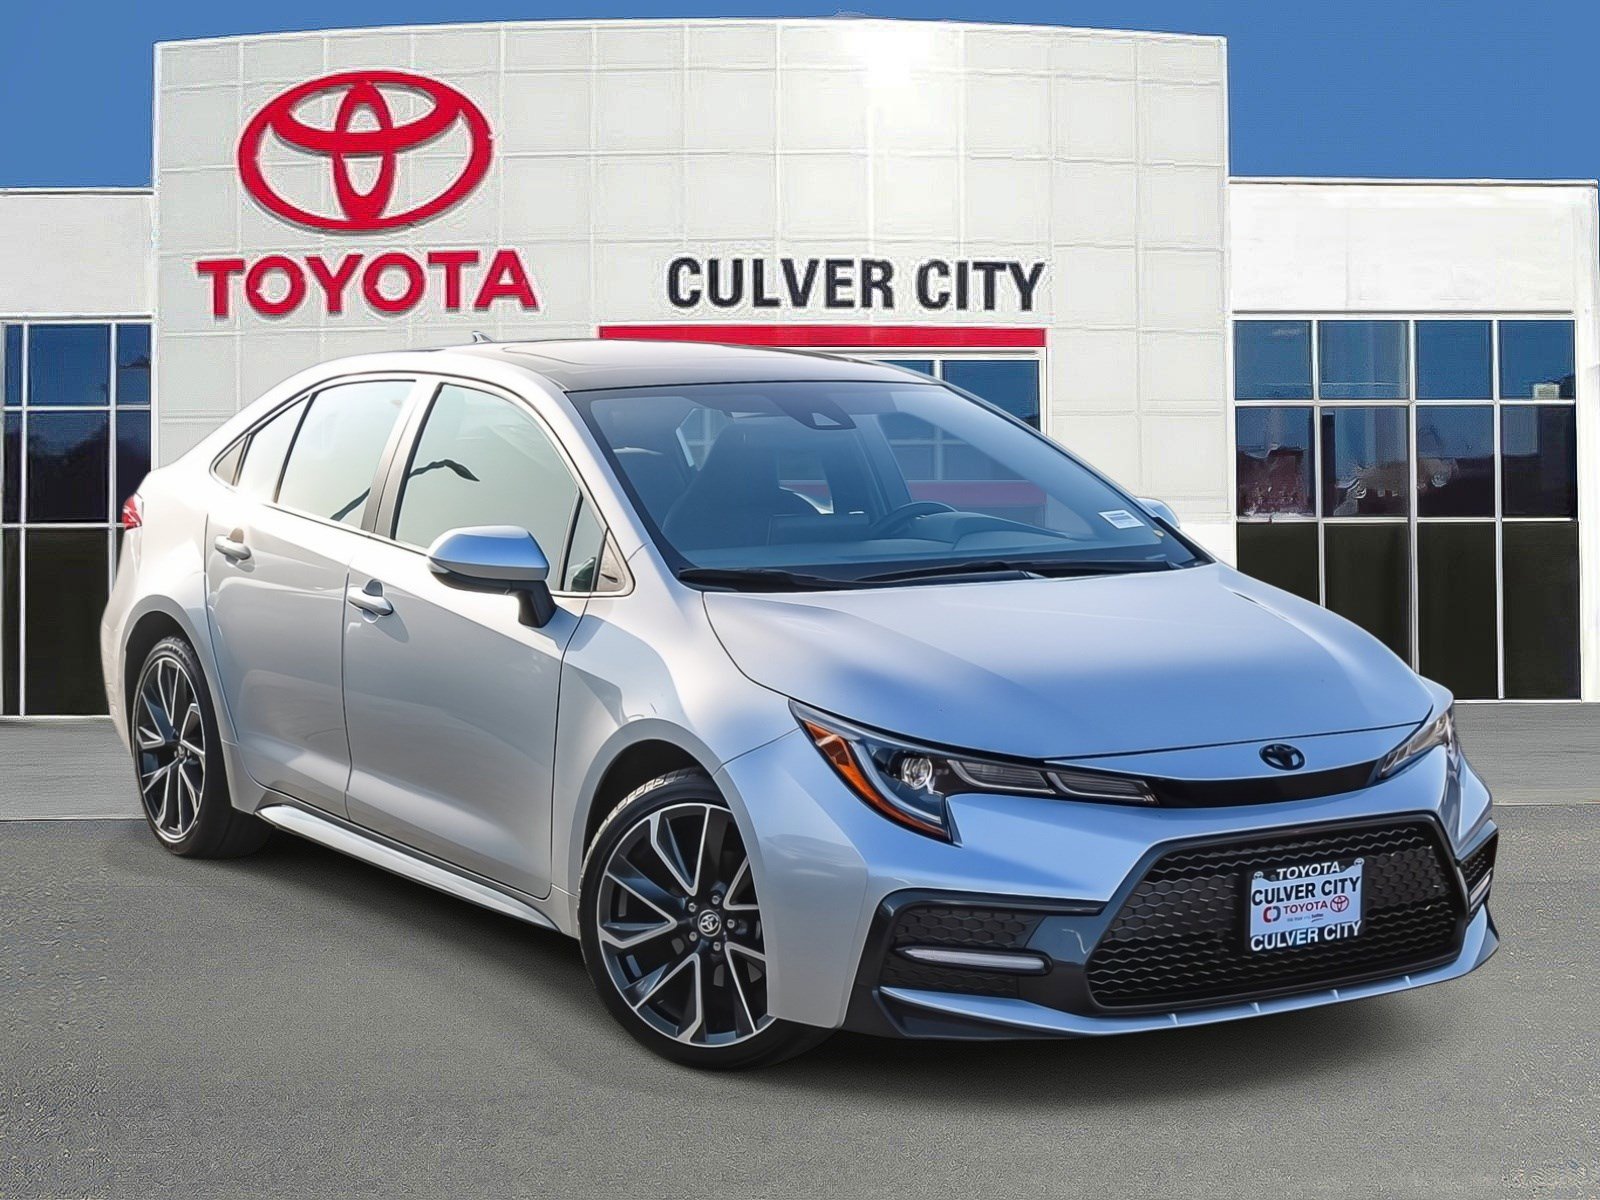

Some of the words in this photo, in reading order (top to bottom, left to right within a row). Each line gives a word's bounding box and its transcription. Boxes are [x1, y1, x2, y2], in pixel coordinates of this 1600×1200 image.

[195, 250, 540, 319] TOYOTA
[667, 257, 894, 309] CULVER
[916, 259, 1045, 311] CITY
[1276, 861, 1340, 880] TOYOTA
[1251, 882, 1316, 906] CULVER
[1321, 876, 1361, 896] CITY
[1284, 900, 1328, 914] TOYOTA
[1250, 928, 1319, 952] CULVER
[1323, 920, 1362, 941] CITY
